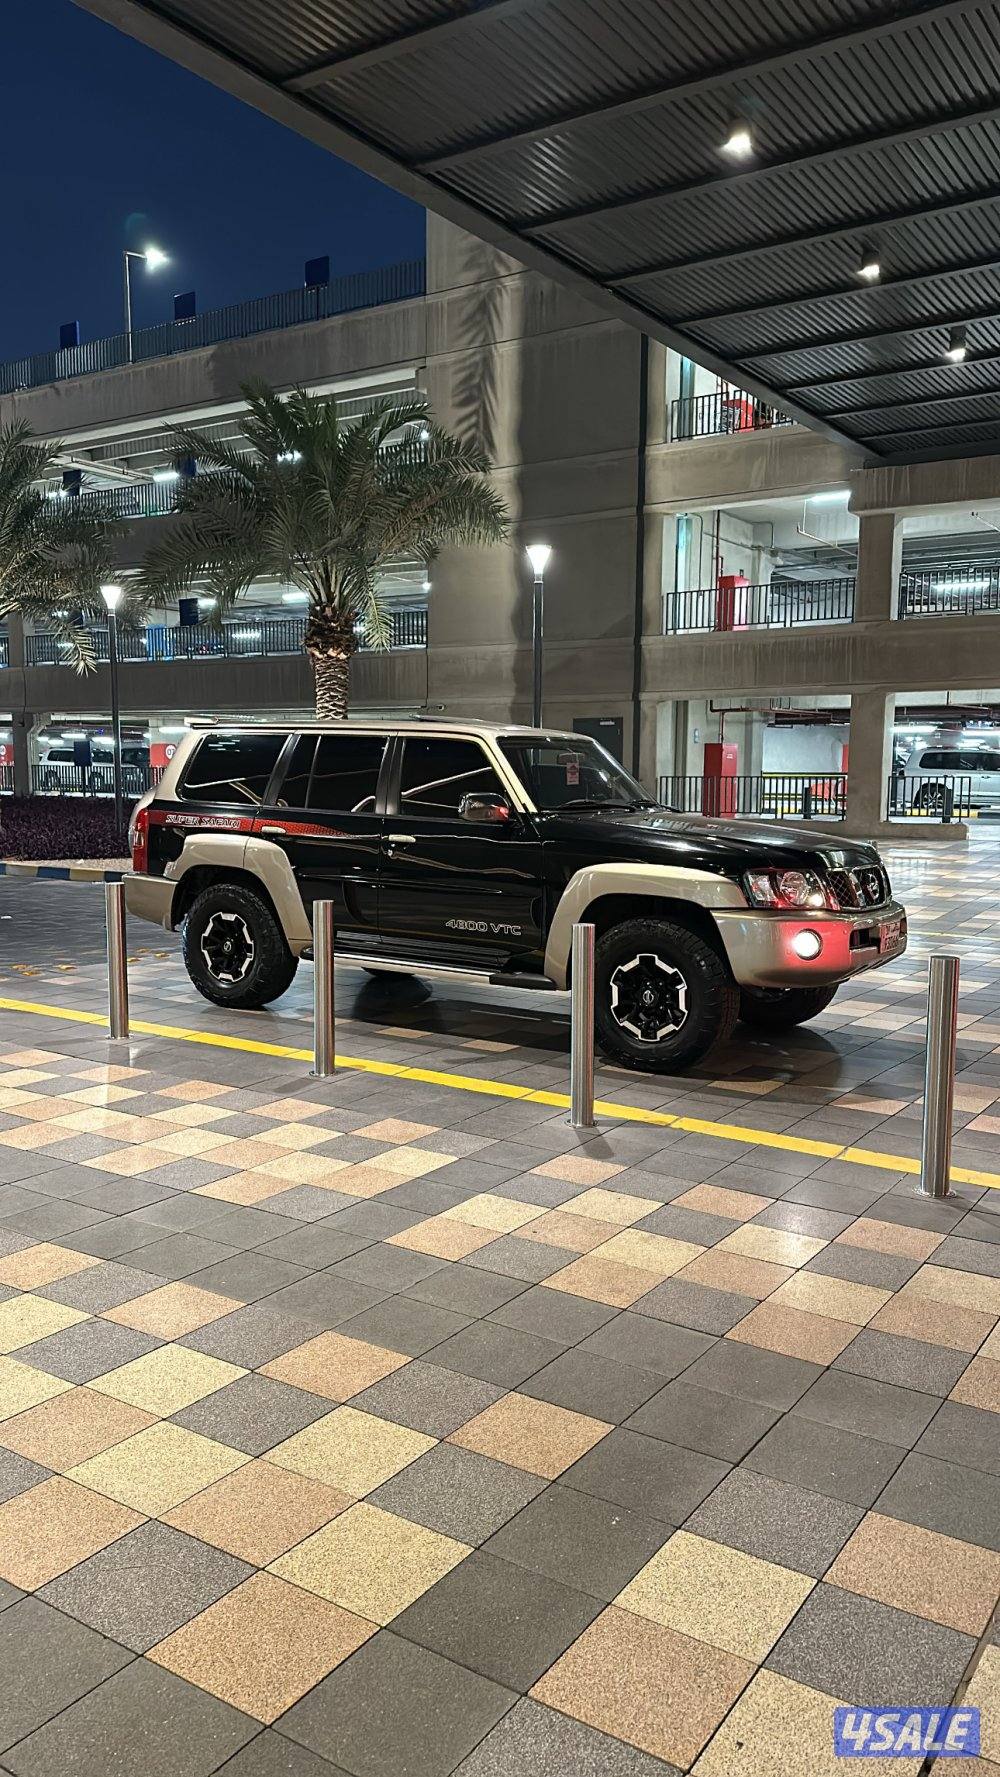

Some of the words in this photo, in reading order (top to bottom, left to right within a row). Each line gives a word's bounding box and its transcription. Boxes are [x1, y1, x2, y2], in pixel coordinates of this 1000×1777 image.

[165, 814, 200, 826] SUPER
[445, 919, 488, 932] 4800
[490, 922, 522, 935] VTC
